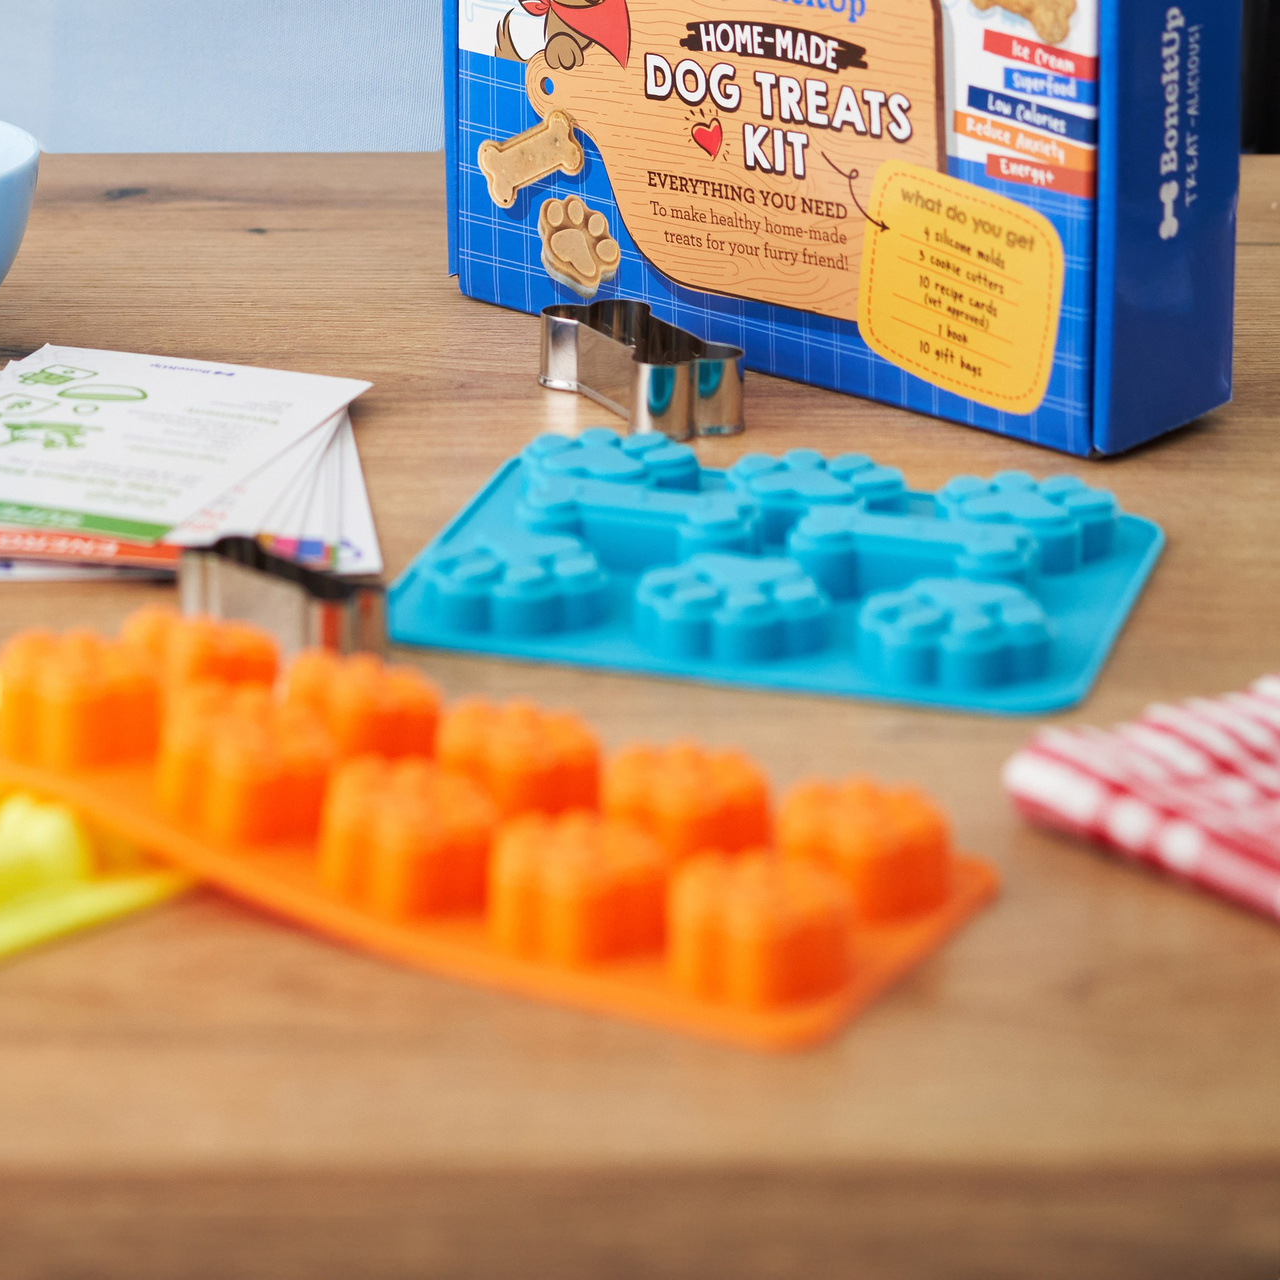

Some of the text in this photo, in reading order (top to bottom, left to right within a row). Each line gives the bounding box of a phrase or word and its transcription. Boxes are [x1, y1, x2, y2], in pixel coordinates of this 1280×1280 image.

[699, 23, 839, 70] HOME-MADE
[1012, 39, 1075, 74] Ice Cream
[644, 53, 913, 142] DOG TREATS
[1012, 72, 1077, 99] Superfood
[1160, 6, 1185, 176] BoneItUp
[987, 93, 1067, 134] Low Calories
[742, 123, 808, 179] KIT
[966, 117, 1065, 165] Reduce Anxiety
[999, 158, 1055, 186] Energy+
[647, 171, 848, 220] EVERYTHING YOU NEED
[649, 201, 848, 245] To make healthy home-made
[901, 188, 1036, 252] what do you get
[664, 230, 850, 271] treats for your furry friend!
[923, 226, 1006, 270] 4 silicone molds
[919, 275, 999, 318] 10 recipe cards
[930, 255, 961, 276] cookie
[966, 270, 1004, 295] cutters
[924, 292, 991, 332] (vet approved)
[947, 325, 969, 344] book
[919, 341, 983, 377] 10 gift bags
